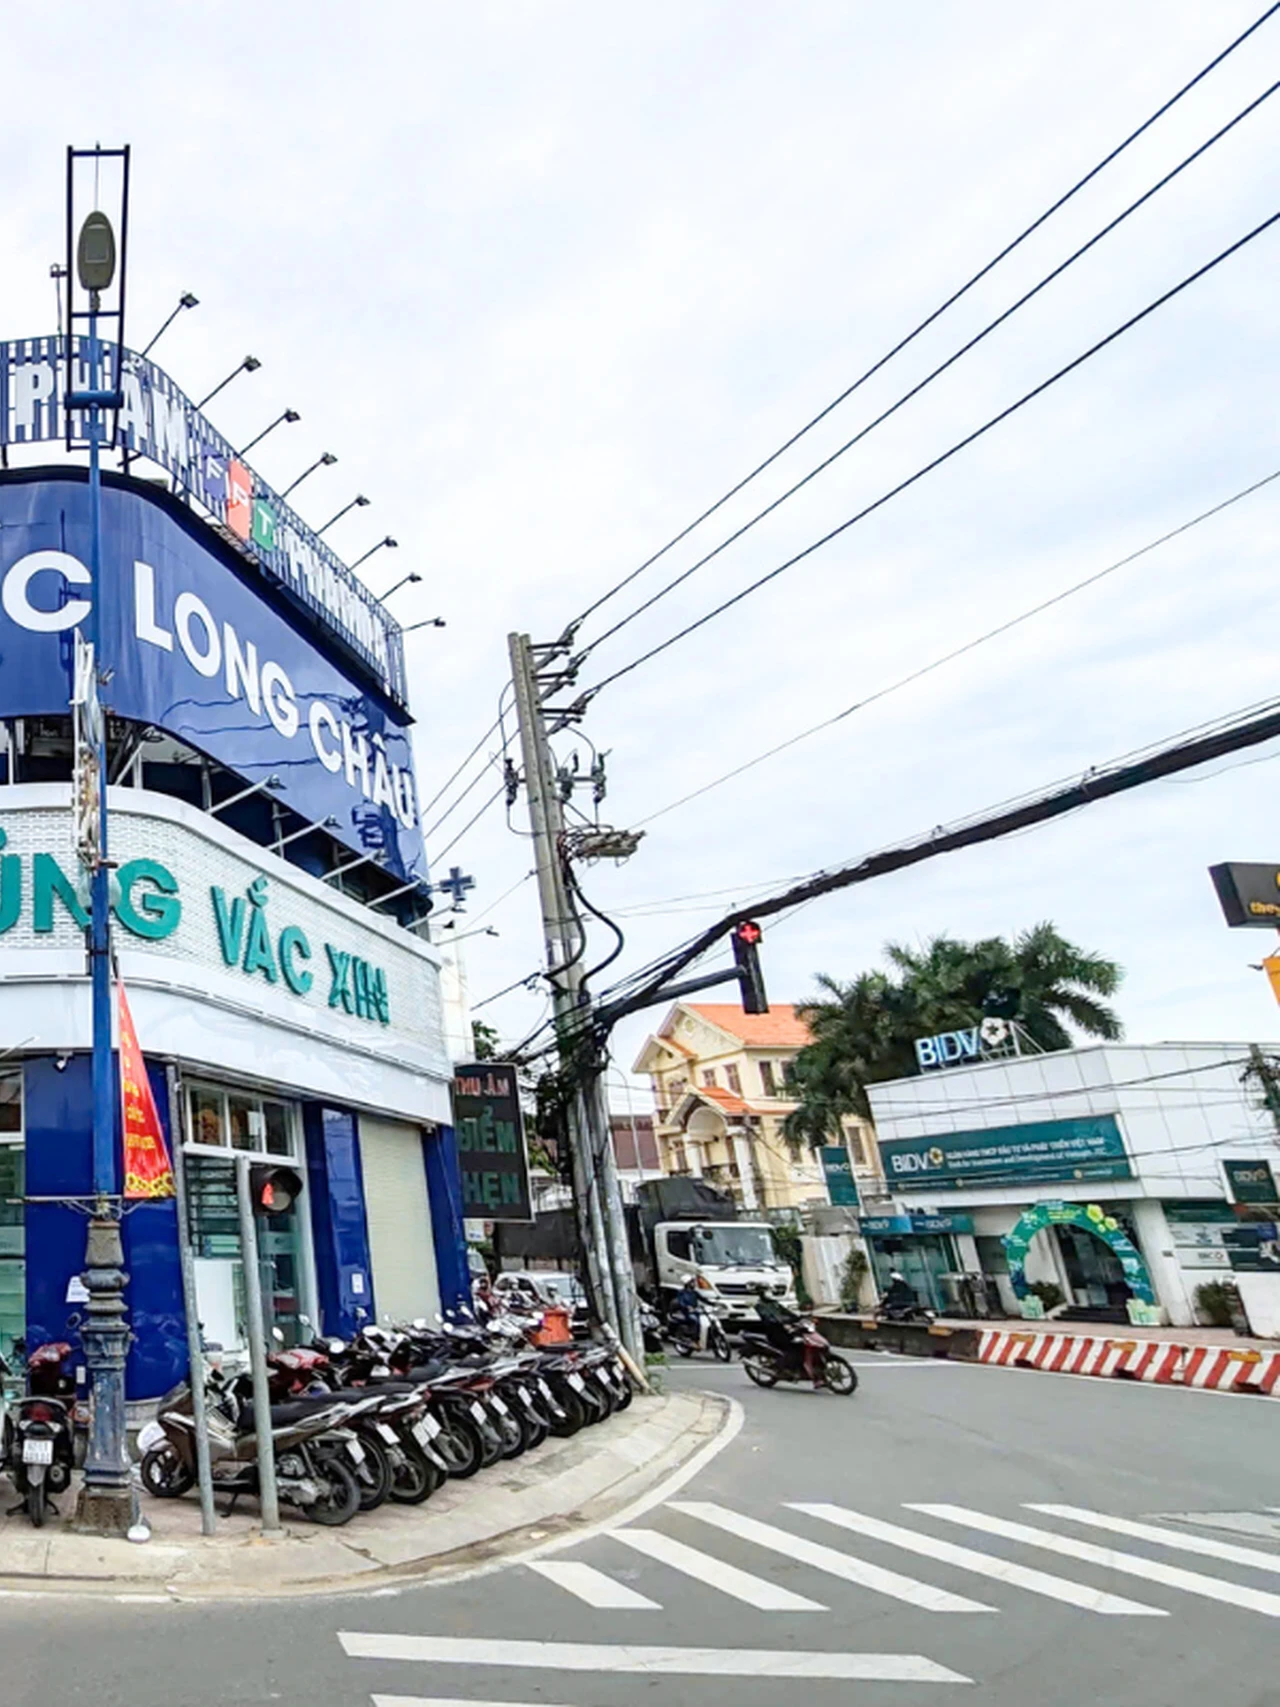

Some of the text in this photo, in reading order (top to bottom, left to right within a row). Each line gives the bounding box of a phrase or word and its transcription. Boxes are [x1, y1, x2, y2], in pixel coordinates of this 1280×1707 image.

[133, 560, 300, 738] LONG
[309, 701, 418, 830] CHÂU
[210, 875, 314, 996] VẮC
[324, 942, 389, 1027] XIN
[914, 1026, 980, 1066] BIDV
[890, 1153, 929, 1174] BIDV
